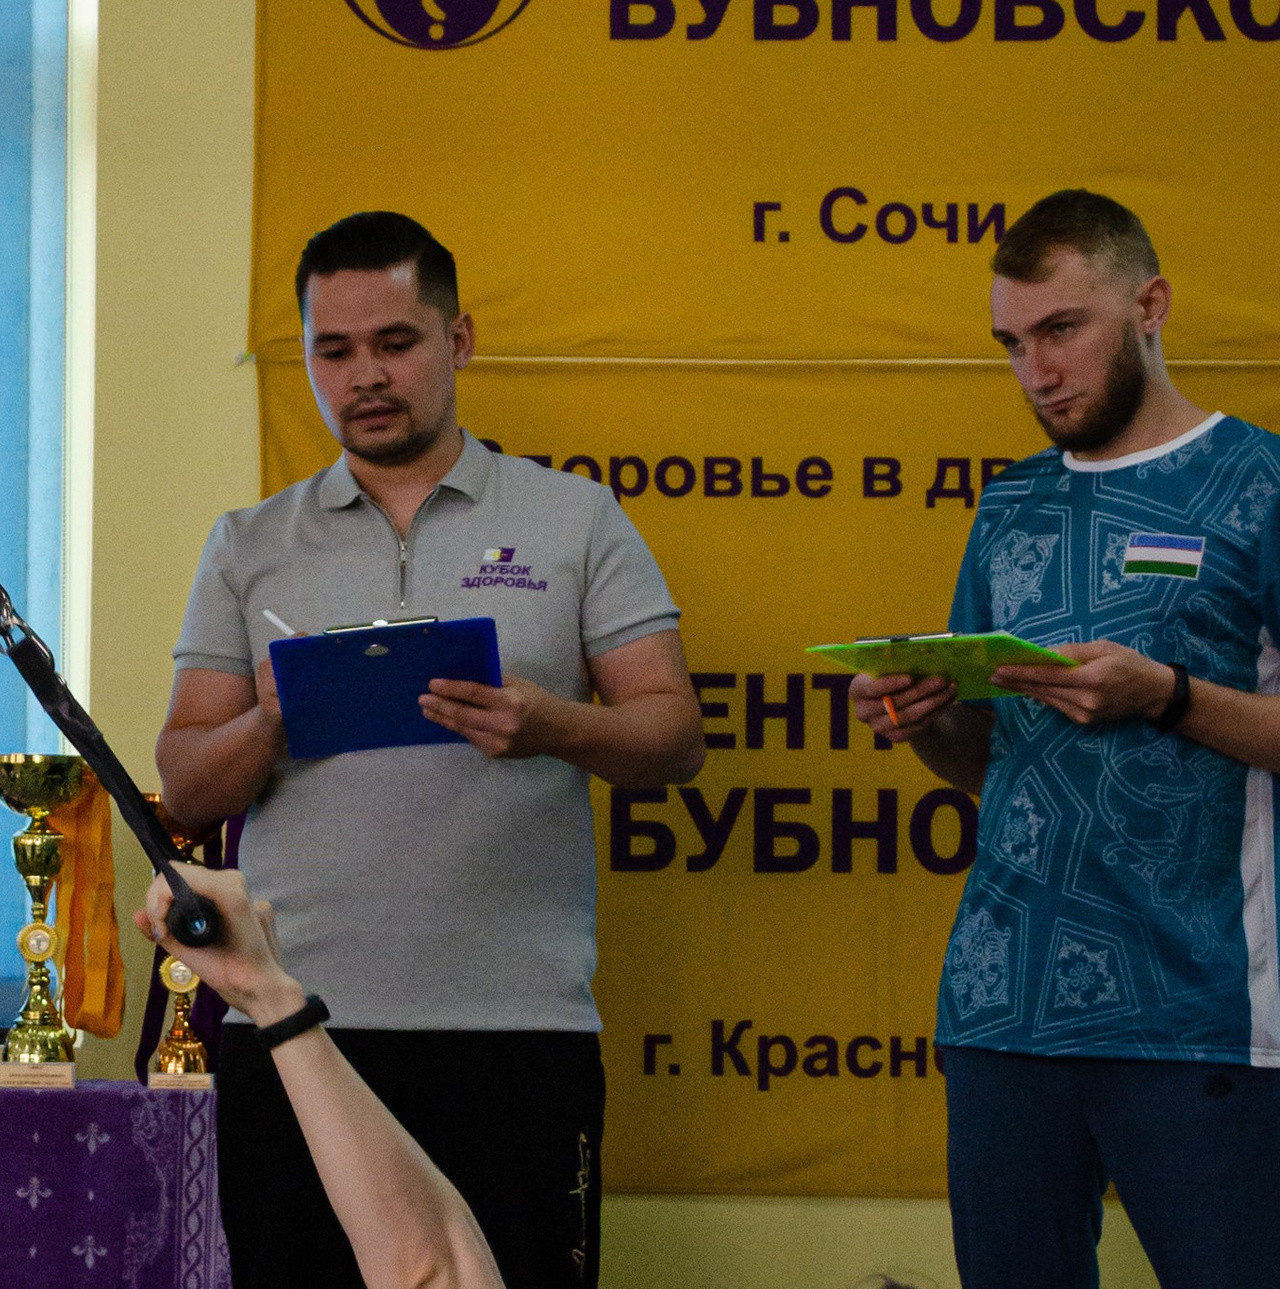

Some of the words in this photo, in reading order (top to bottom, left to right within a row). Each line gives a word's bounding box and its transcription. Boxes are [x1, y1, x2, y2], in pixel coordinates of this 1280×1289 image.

[753, 201, 790, 243] г.
[819, 186, 1006, 244] Сочи
[862, 456, 903, 500] в
[460, 575, 548, 592] ЗДОРОВЬЯ
[478, 564, 532, 576] КУБОК
[643, 1034, 680, 1076] г.
